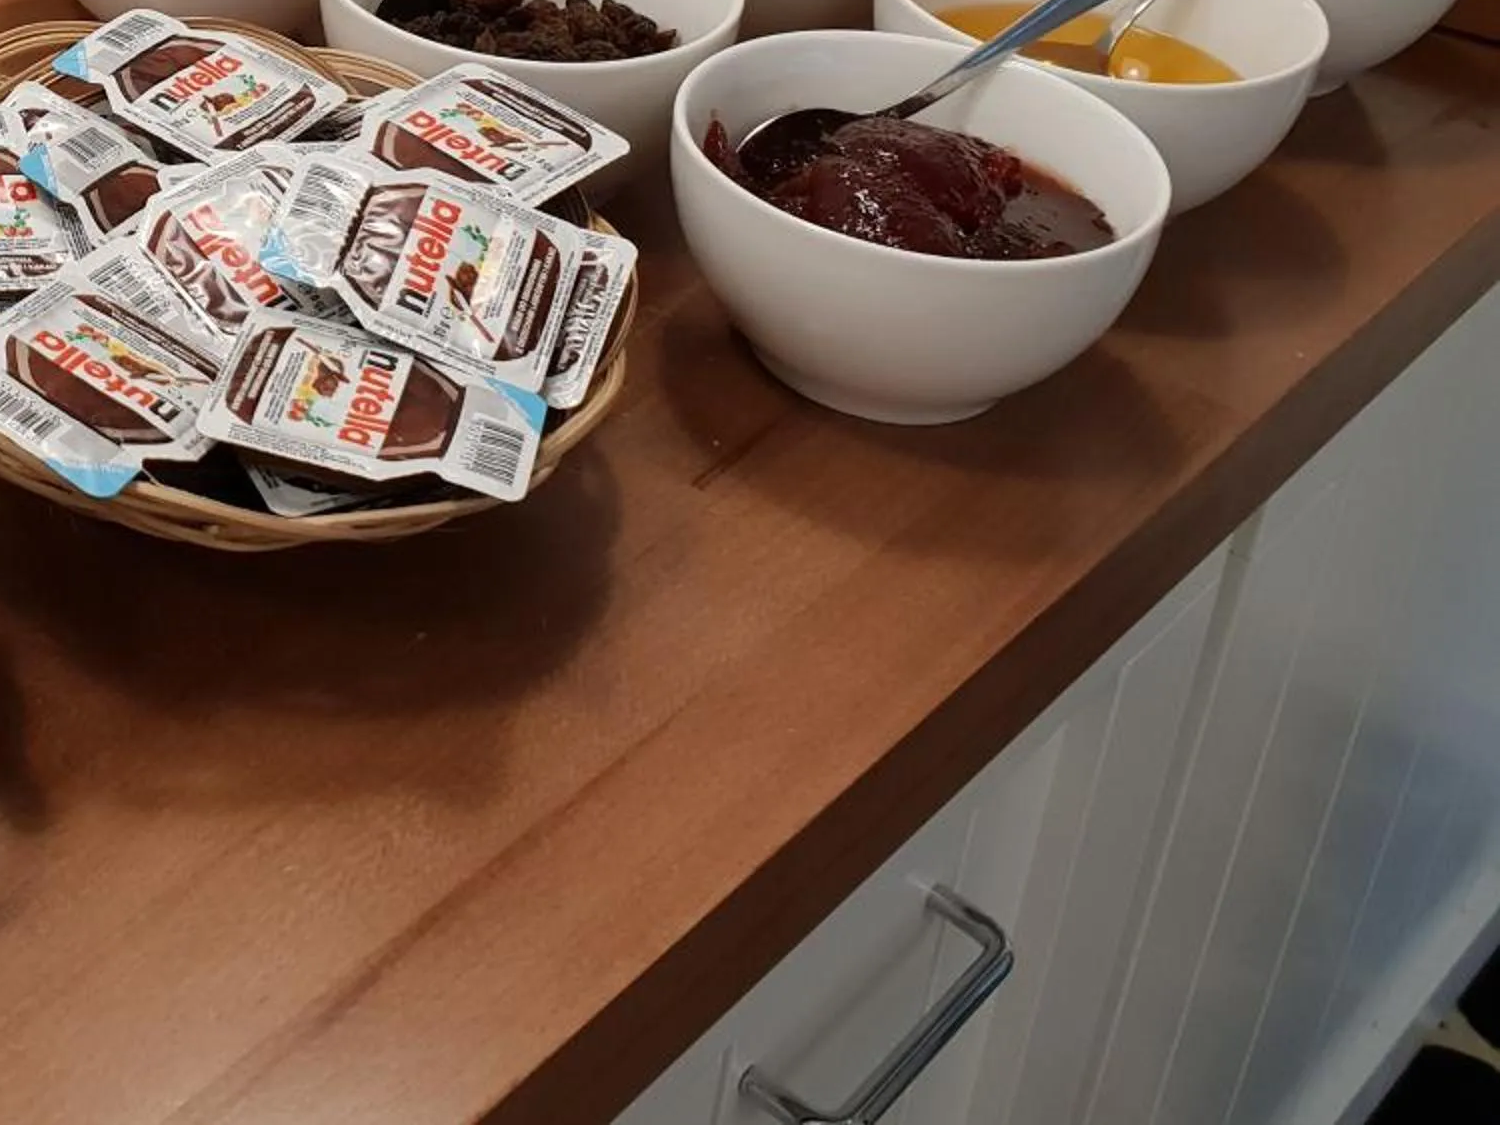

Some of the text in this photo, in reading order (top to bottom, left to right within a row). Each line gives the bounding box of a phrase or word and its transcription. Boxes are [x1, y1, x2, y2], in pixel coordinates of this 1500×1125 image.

[150, 54, 244, 112] nutella
[406, 111, 528, 180] nutella
[397, 199, 463, 315] nutella
[34, 331, 182, 422] nutella
[336, 351, 399, 450] nutella
